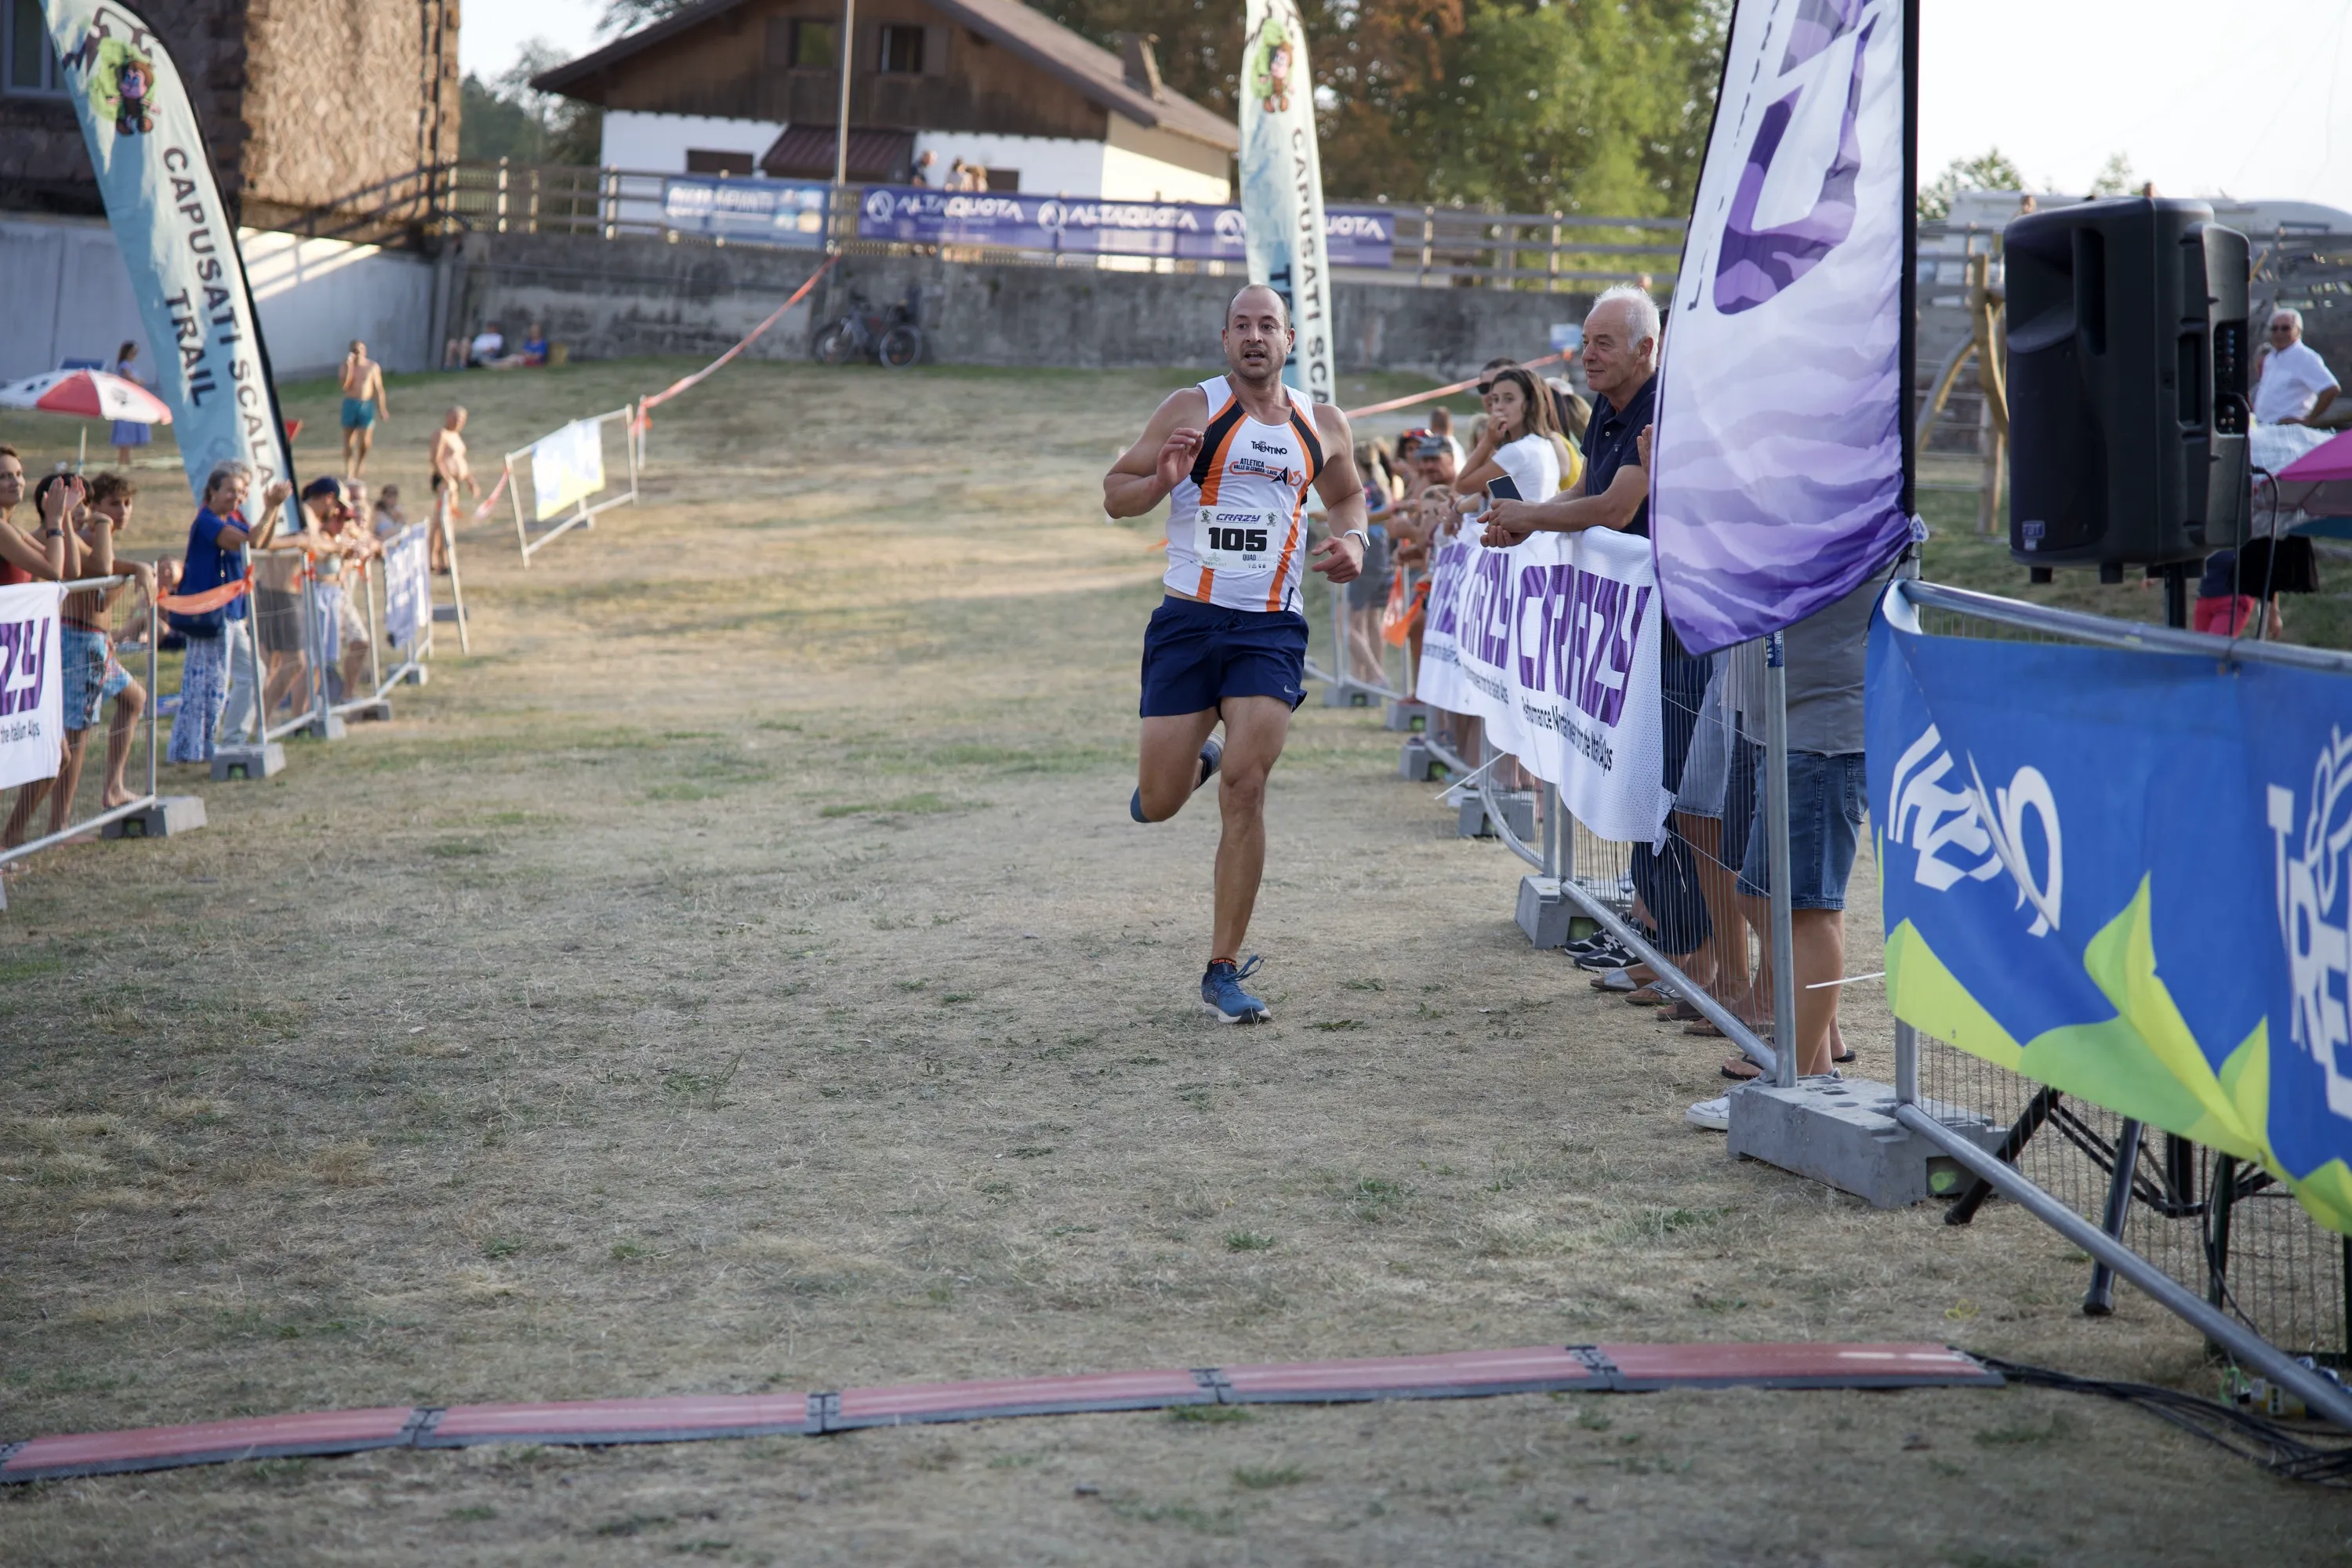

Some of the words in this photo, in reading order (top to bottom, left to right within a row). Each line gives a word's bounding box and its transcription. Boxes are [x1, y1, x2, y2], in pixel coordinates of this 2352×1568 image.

[162, 147, 243, 347] CAPUSATI
[1292, 127, 1321, 321] CAPUSATI
[165, 287, 217, 408] TRAIL
[1240, 458, 1265, 468] ATLETICA
[1250, 441, 1287, 455] TRENTINO
[1208, 527, 1268, 552] 105
[1215, 514, 1261, 522] CRAZY
[1516, 564, 1653, 728] CRAZY
